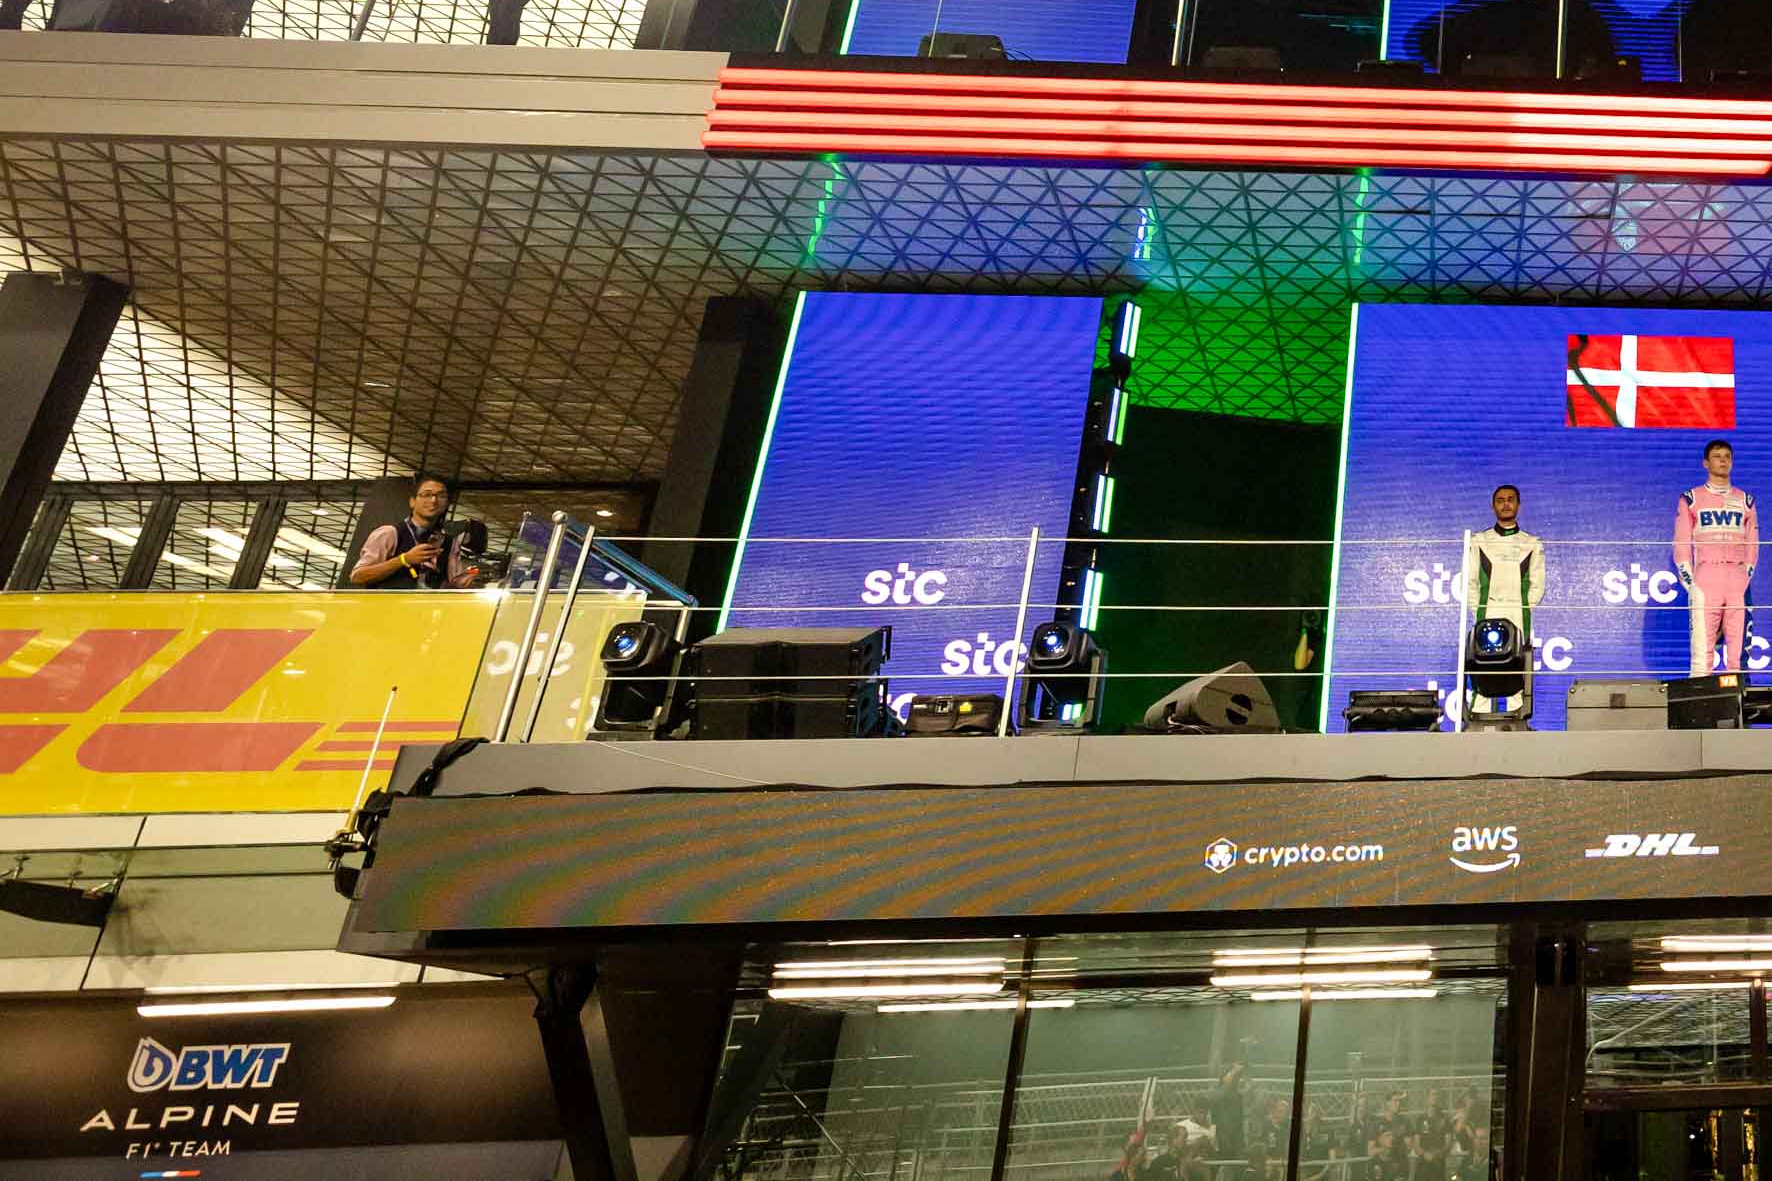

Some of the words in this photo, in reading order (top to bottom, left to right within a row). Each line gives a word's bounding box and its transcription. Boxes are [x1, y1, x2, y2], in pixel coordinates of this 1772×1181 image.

[1699, 509, 1744, 527] BWT
[861, 562, 948, 605] stc
[1601, 563, 1679, 604] stc
[940, 631, 1029, 676] stc
[1451, 825, 1518, 852] aws
[1600, 833, 1703, 858] DHL
[1243, 842, 1384, 868] crypto.com
[169, 1043, 292, 1091] BWT
[80, 1102, 300, 1132] ALPINE
[169, 1139, 232, 1158] TEAM
